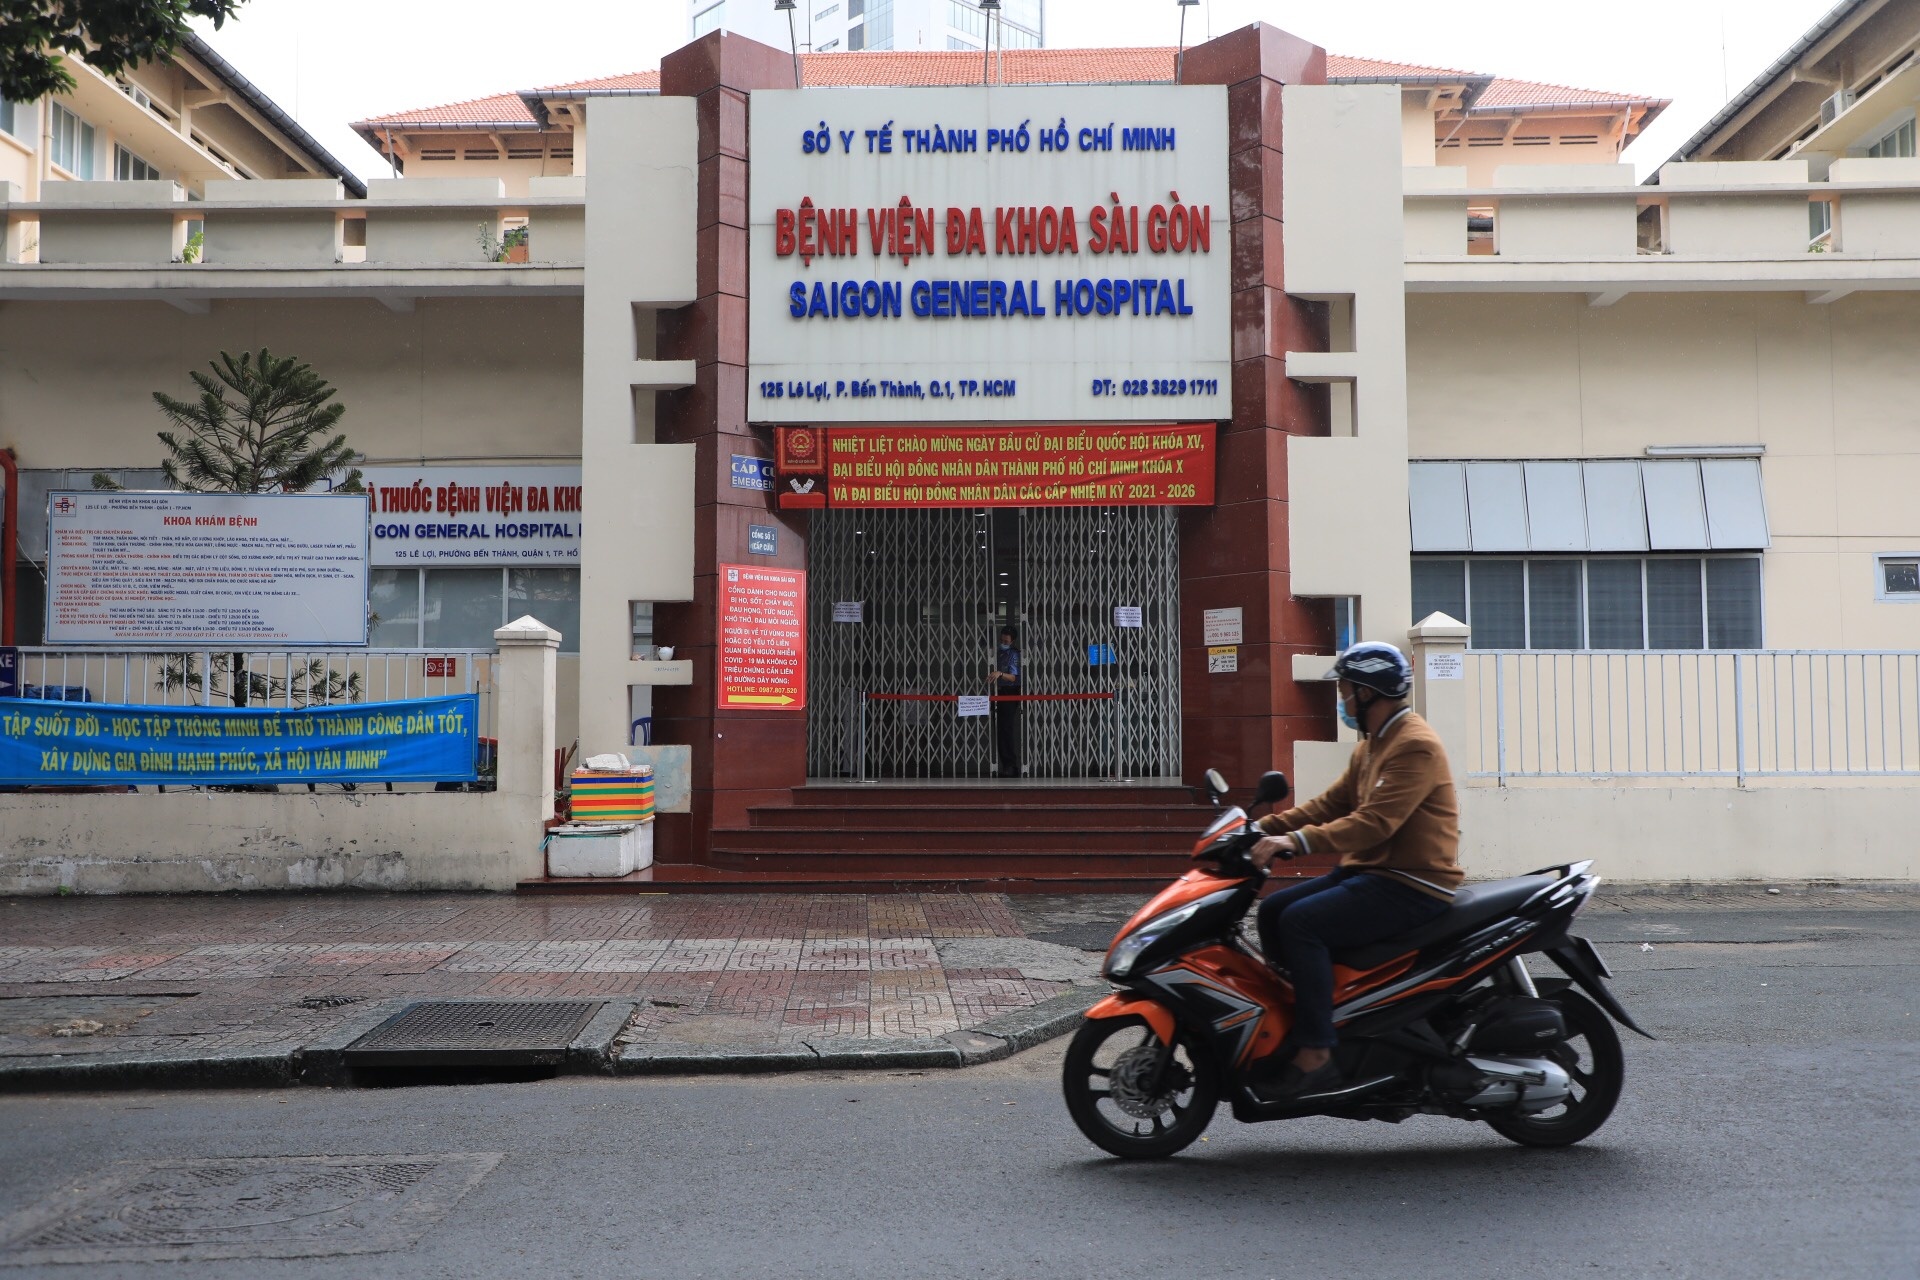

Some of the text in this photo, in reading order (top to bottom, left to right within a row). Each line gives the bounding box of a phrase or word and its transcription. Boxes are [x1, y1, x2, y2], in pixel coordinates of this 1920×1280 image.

[803, 118, 1176, 152] SỞ Y TẾ THÀNH PHỐ HỒ CHÍ MINH
[776, 190, 1211, 266] BỆNH VIỆN ĐA KHOA SÀI GÒN
[790, 278, 1193, 318] SAIGON GENERAL HOSPITAL
[760, 379, 1016, 401] 125 Lê Lợi, P. Bến Thành, Q.1, TP. HCM
[1092, 379, 1218, 396] ĐT: 028 3829 1711
[833, 434, 1204, 454] NHIỆT LIỆT CHÀO MỪNG NGÀY BẦU CỬ ĐẠI BIỂU QUỐC HỘI KHÓA XV,
[731, 459, 757, 474] CẤP
[833, 456, 1183, 479] ĐẠI BIỂU HỘI ĐỒNG NHÂN DÂN THÀNH PHỐ HỒ CHÍ MINH KHÓA X
[380, 479, 432, 512] THUỐC
[437, 482, 480, 516] BỆNH
[486, 481, 523, 516] VIỆN
[527, 487, 549, 512] ĐA
[833, 481, 1196, 503] VÀ ĐẠI BIỂU HỘI ĐỒNG NHÂN DÂN CÁC CẤP NHIỆM KỲ 2021 2026
[163, 514, 258, 528] KHOA KHÁM BỆNH
[415, 523, 489, 538] GENERAL
[495, 523, 573, 538] HOSPITAL
[395, 550, 407, 558] 125
[409, 549, 420, 558] LÊ
[422, 550, 437, 559] LỢI,
[439, 549, 471, 558] PHƯỜNG
[473, 548, 489, 558] BẾN
[492, 549, 519, 559] THÀNH,
[522, 549, 543, 559] QUẬN
[3, 706, 468, 740] TẬP SUỐT ĐỜI HỌC TẬP THÔNG MINH ĐỂ TRỞ THÀNH CÔNG DÂN TỐT,
[41, 747, 68, 770] XÂY
[73, 750, 110, 774] DỰNG
[115, 753, 136, 771] GIA
[141, 748, 172, 770] ĐÌNH
[178, 753, 214, 770] HẠNH
[220, 748, 259, 774] PHÚC,
[265, 747, 281, 770] XÃ
[288, 747, 309, 773] HỘI
[315, 751, 340, 769] VĂN
